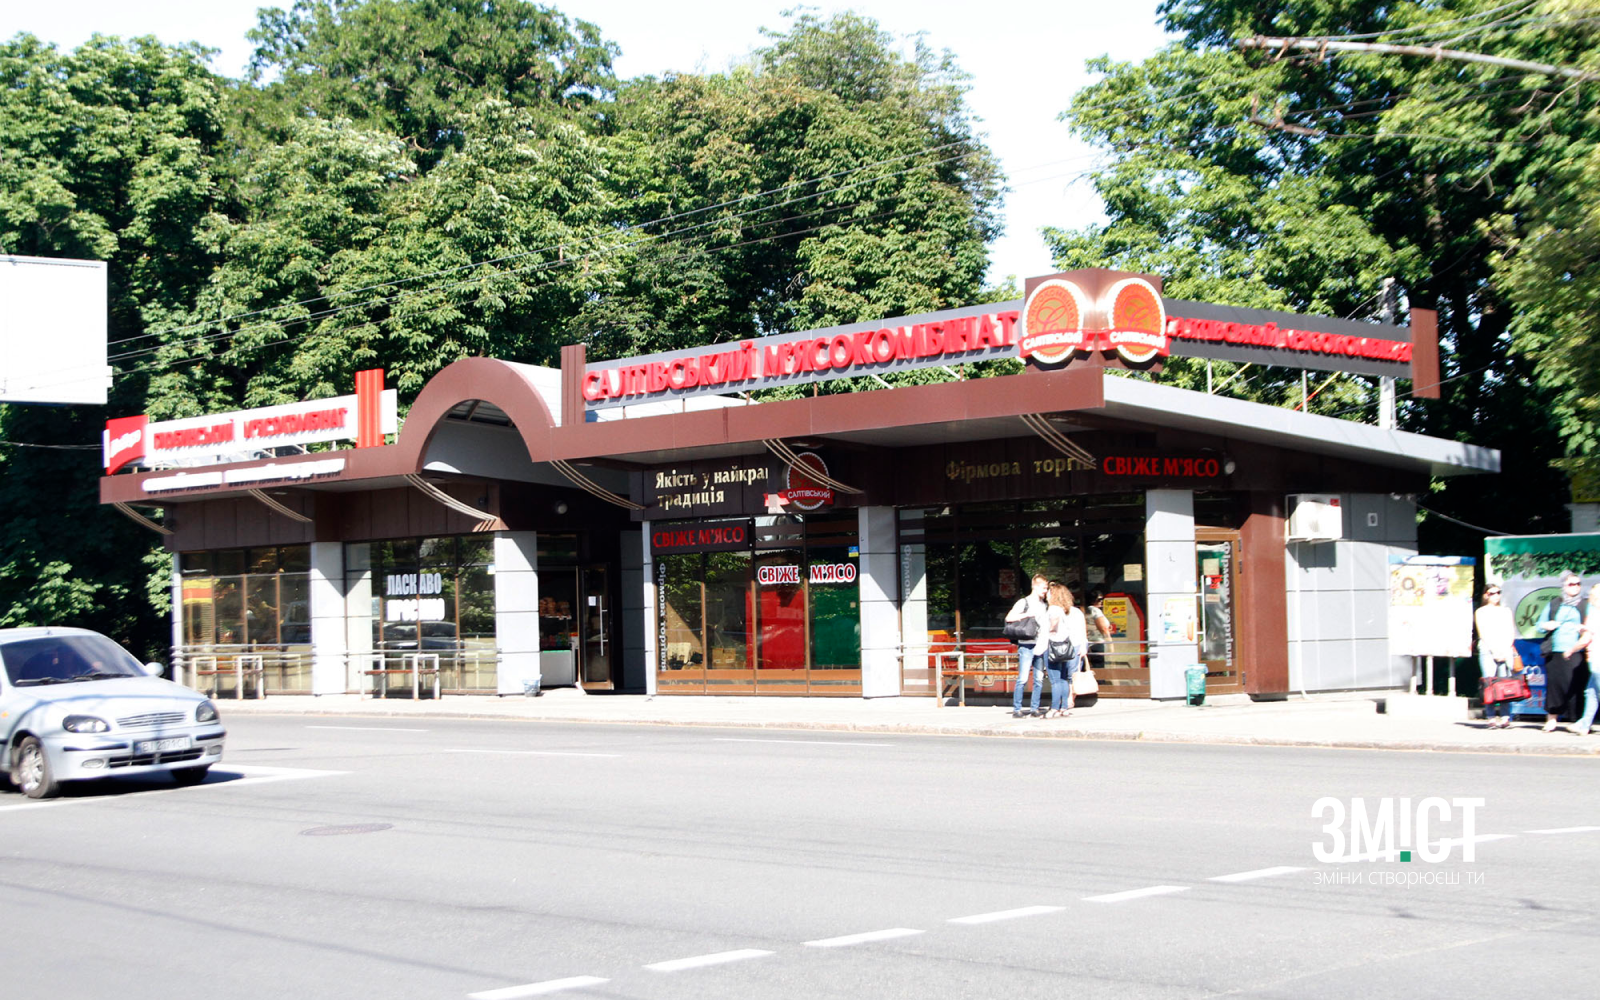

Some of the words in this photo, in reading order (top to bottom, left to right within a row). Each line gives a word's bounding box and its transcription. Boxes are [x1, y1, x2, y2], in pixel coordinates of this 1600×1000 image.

[582, 341, 760, 401] САЛТІВСЬКИЙ
[763, 310, 1020, 378] М'ЯСОКОМБІНАТ
[655, 468, 698, 489] Якість
[702, 471, 711, 490] у
[714, 464, 769, 486] найкра
[945, 460, 1022, 484] Фірмова
[1103, 456, 1160, 476] СВІЖЕ
[1163, 457, 1220, 477] М'ЯСО
[657, 485, 725, 511] традиція
[787, 488, 832, 500] САЛТІВСЬКИЙ
[653, 529, 697, 548] СВІЖЕ
[700, 526, 745, 546] М'ЯСО
[758, 565, 800, 584] СВІЖЕ
[810, 563, 856, 583] М'ЯСО
